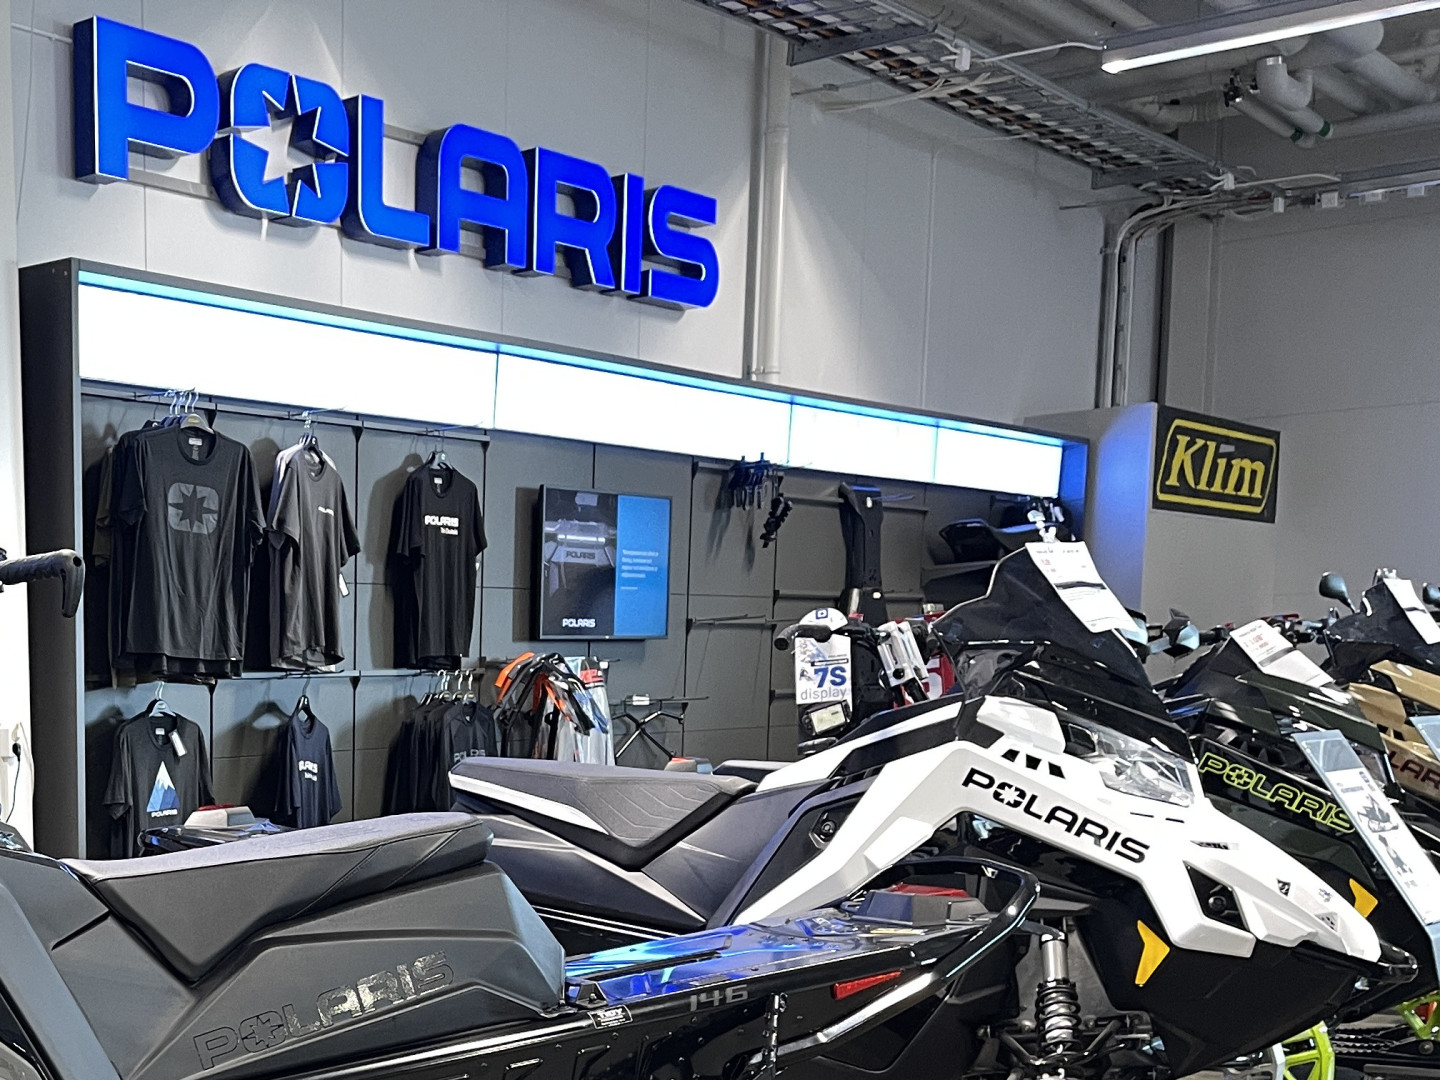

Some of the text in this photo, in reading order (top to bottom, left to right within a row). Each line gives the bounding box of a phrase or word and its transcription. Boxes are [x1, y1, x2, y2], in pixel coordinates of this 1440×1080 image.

[73, 15, 719, 309] POLARIS
[1165, 434, 1263, 499] Klim
[562, 618, 596, 628] POLARIS
[800, 687, 847, 701] display
[814, 666, 847, 688] 7S
[961, 767, 1150, 864] POLARIS
[1198, 752, 1356, 833] POLARIS
[193, 951, 454, 1071] POLARIS
[689, 984, 748, 1012] 146
